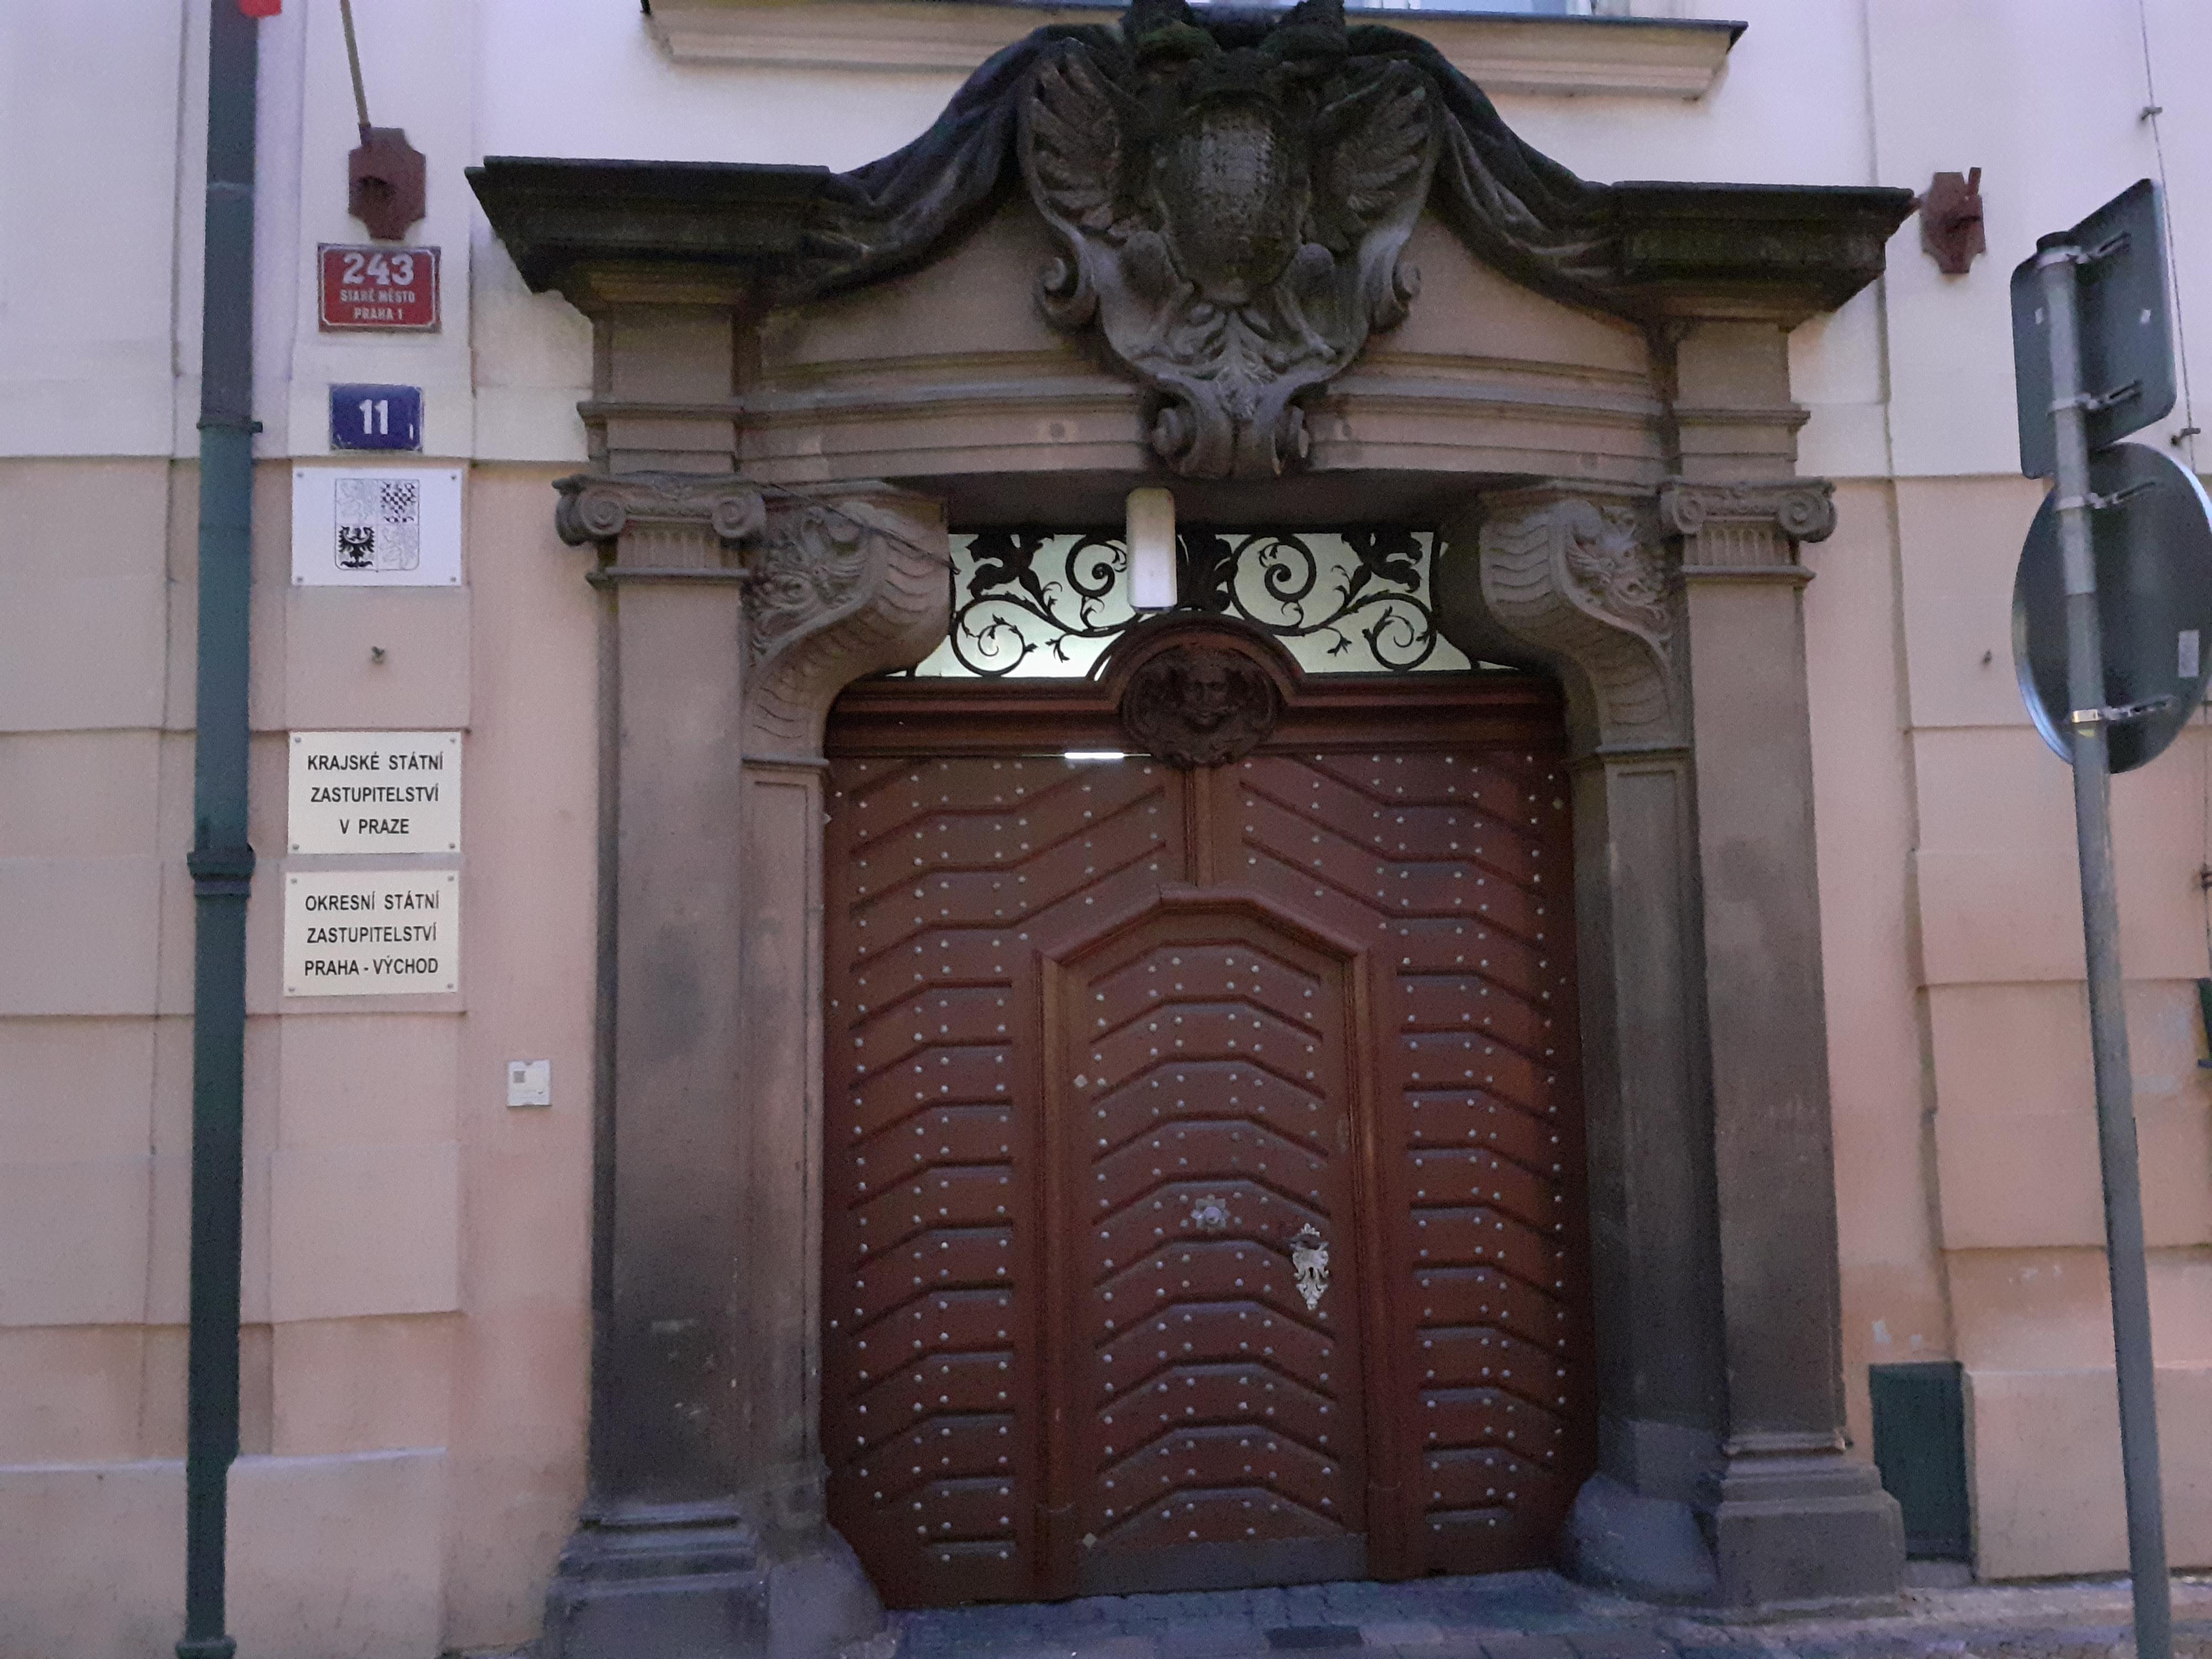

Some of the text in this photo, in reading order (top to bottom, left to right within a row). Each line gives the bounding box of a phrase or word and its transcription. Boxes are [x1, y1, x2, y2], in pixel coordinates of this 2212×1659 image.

[343, 252, 414, 285] 243
[353, 307, 403, 320] PRAHA 1
[359, 399, 389, 435] 11
[307, 751, 444, 770] KRAJSKÉ STÁTNÍ
[311, 783, 439, 802] ZASTUPITELSTVÍ
[340, 818, 410, 834] V PRAZE
[305, 890, 440, 911] OKRESNÍ STÁTNÍ
[307, 922, 437, 943] ZASTUPITELSTVÍ
[305, 959, 360, 976] PRAHA
[372, 956, 439, 975] VÝCHOD
